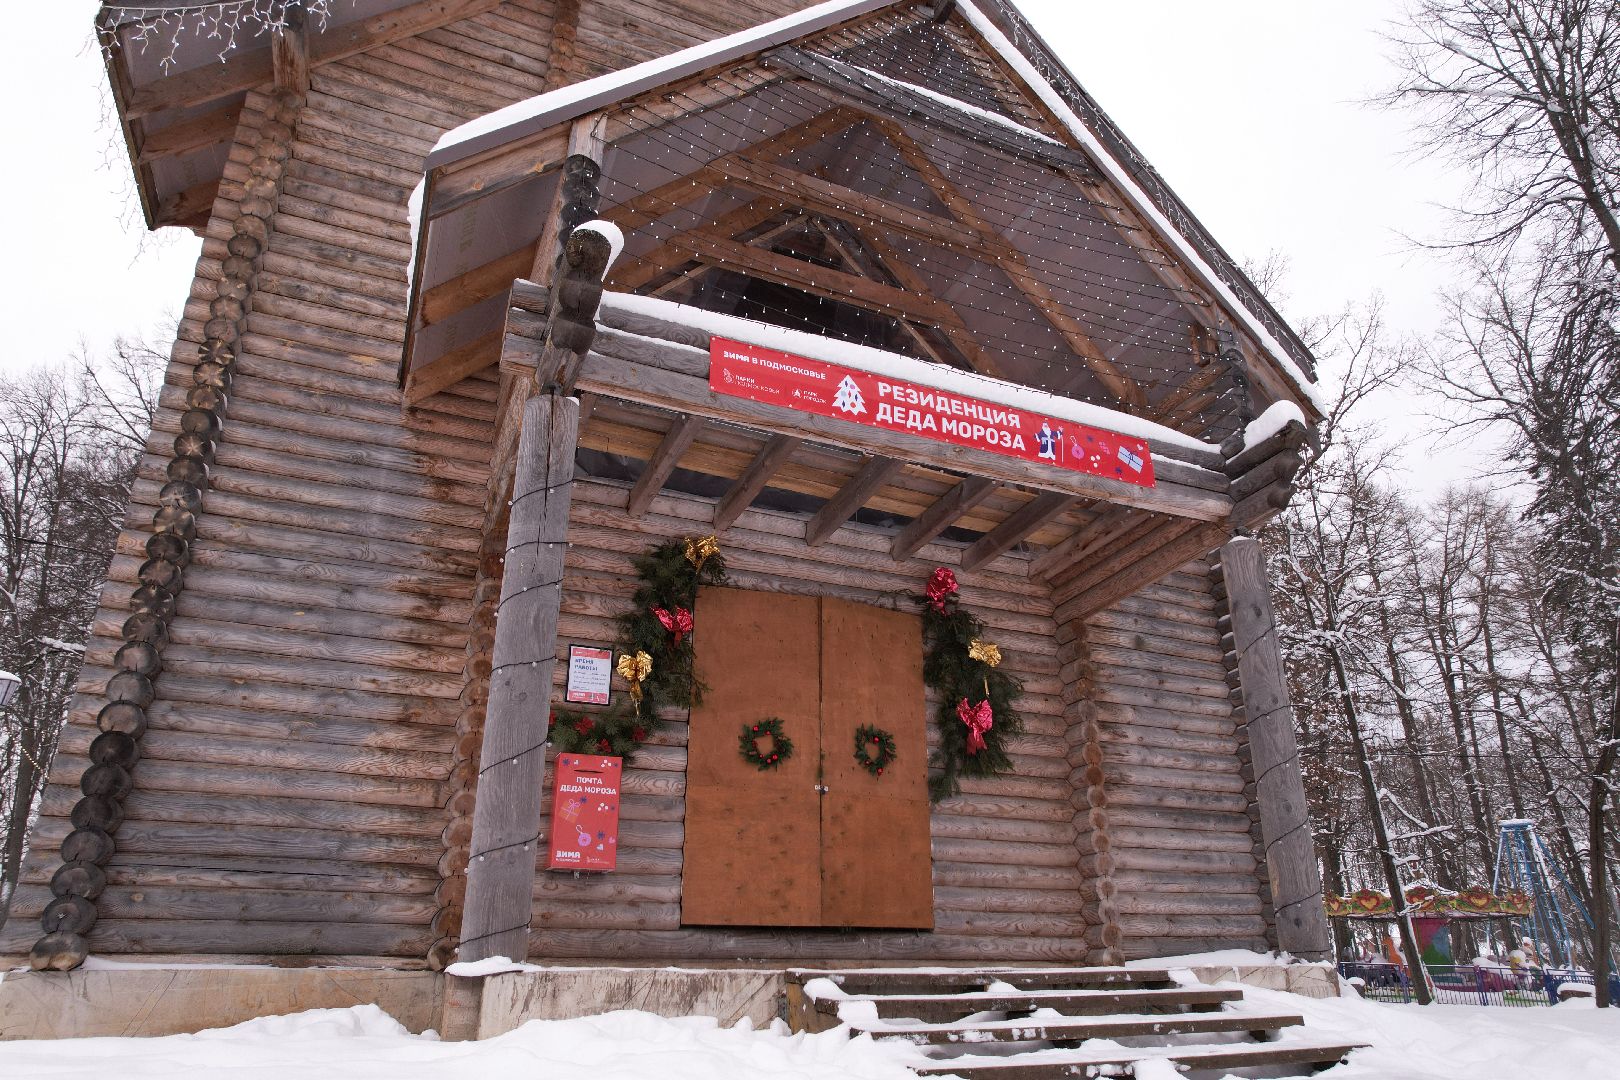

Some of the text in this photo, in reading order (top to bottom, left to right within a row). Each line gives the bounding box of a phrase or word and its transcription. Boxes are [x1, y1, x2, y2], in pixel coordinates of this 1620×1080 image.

[752, 356, 758, 364] В
[760, 359, 826, 380] ПОДМОСКОВЬЕ
[735, 374, 755, 384] ПАРКИ
[877, 381, 1021, 429] РЕЗИДЕНЦИЯ
[876, 402, 1026, 451] ДЕДА МОРОЗА
[576, 776, 602, 785] ПОЧТА
[560, 784, 616, 795] ДЕДА МОРОЗА
